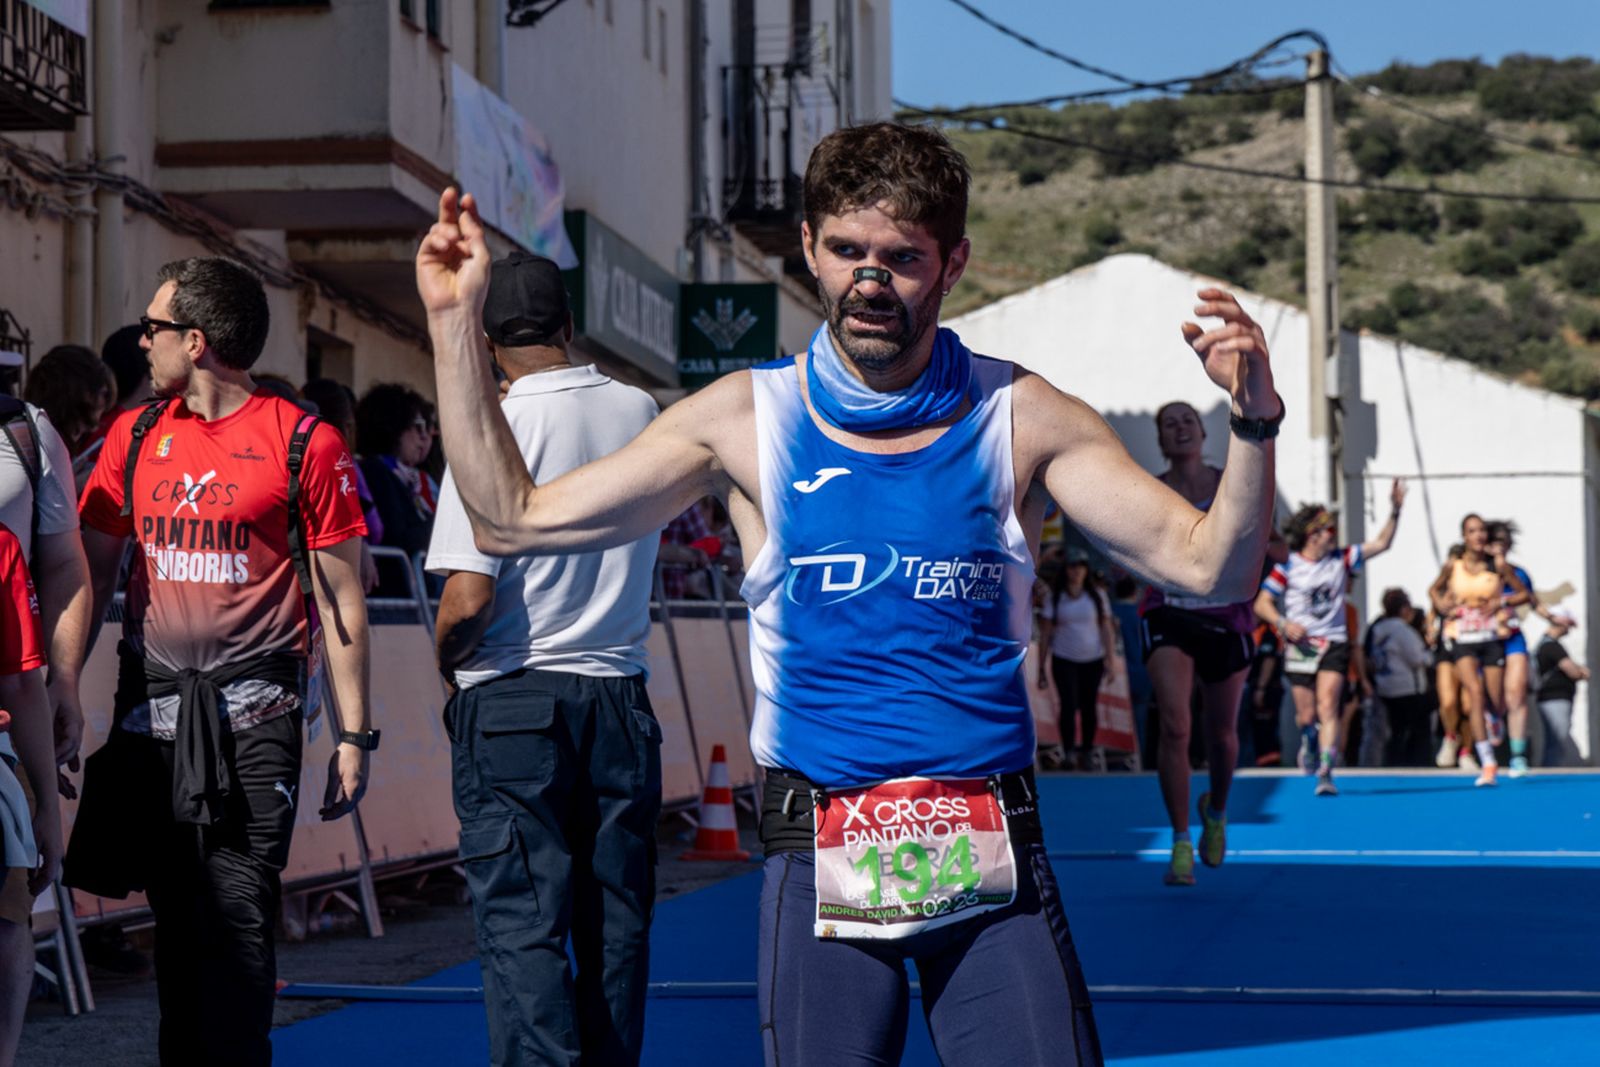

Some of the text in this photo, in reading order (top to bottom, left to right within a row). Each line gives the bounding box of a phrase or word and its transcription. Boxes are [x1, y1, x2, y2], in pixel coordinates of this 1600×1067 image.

[152, 480, 239, 506] CROSS
[142, 515, 251, 551] PANTANO
[901, 556, 1004, 582] Training
[913, 577, 977, 599] DAY
[840, 794, 871, 829] X
[874, 796, 971, 826] CROSS
[842, 820, 975, 851] PANTANO DEL
[854, 835, 982, 905] 194
[867, 908, 898, 919] DAVID
